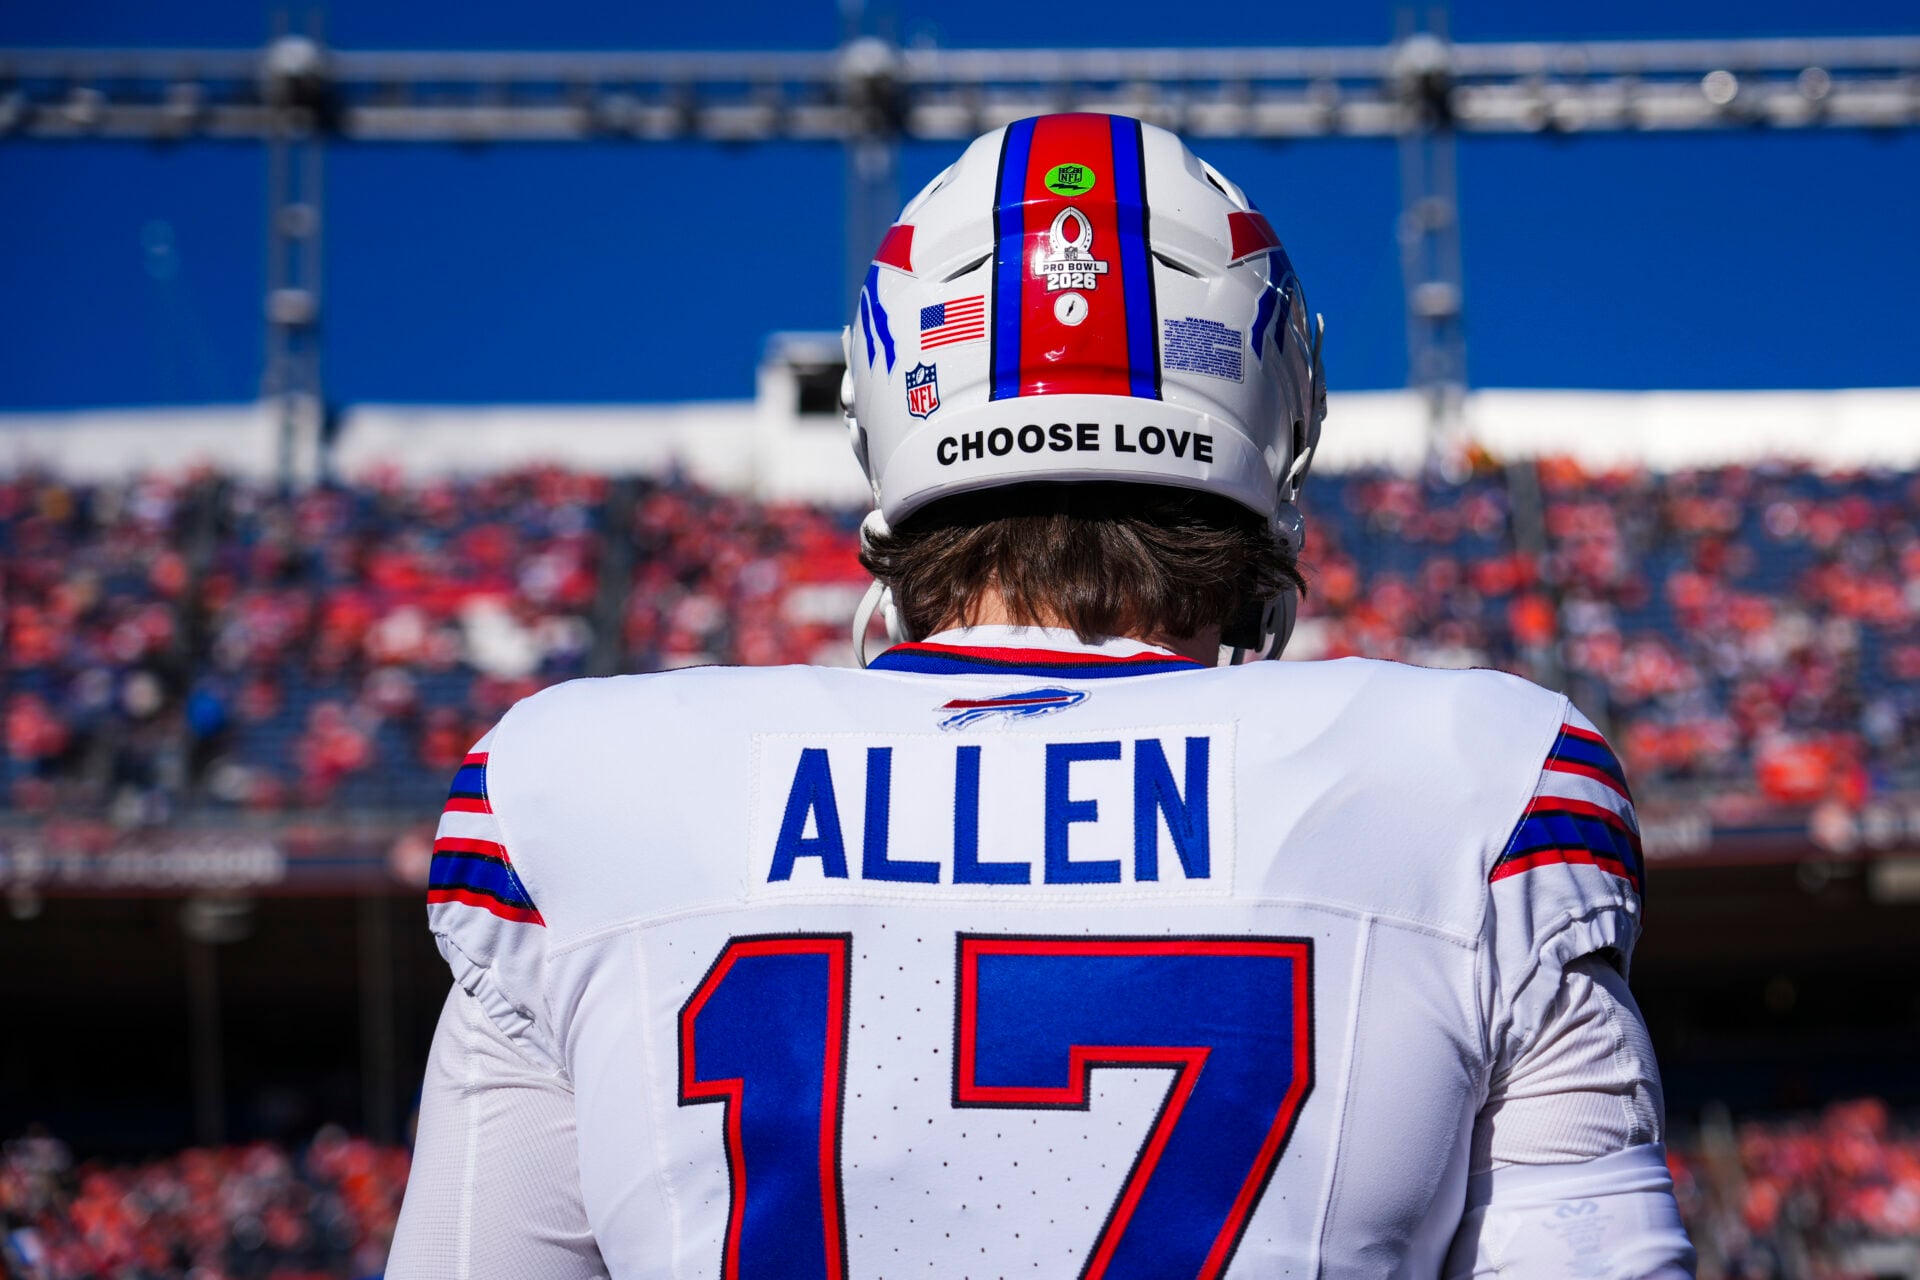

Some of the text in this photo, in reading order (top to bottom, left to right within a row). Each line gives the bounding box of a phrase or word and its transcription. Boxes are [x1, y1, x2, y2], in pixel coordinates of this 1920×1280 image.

[1061, 173, 1081, 182] NFL
[1043, 262, 1100, 272] PRO BOWL
[1047, 273, 1096, 291] 2026
[1185, 316, 1225, 328] WARNING
[910, 383, 937, 414] NFL
[936, 423, 1213, 466] CHOOSE LOVE
[767, 736, 1210, 884] ALLEN
[678, 932, 1316, 1280] 17
